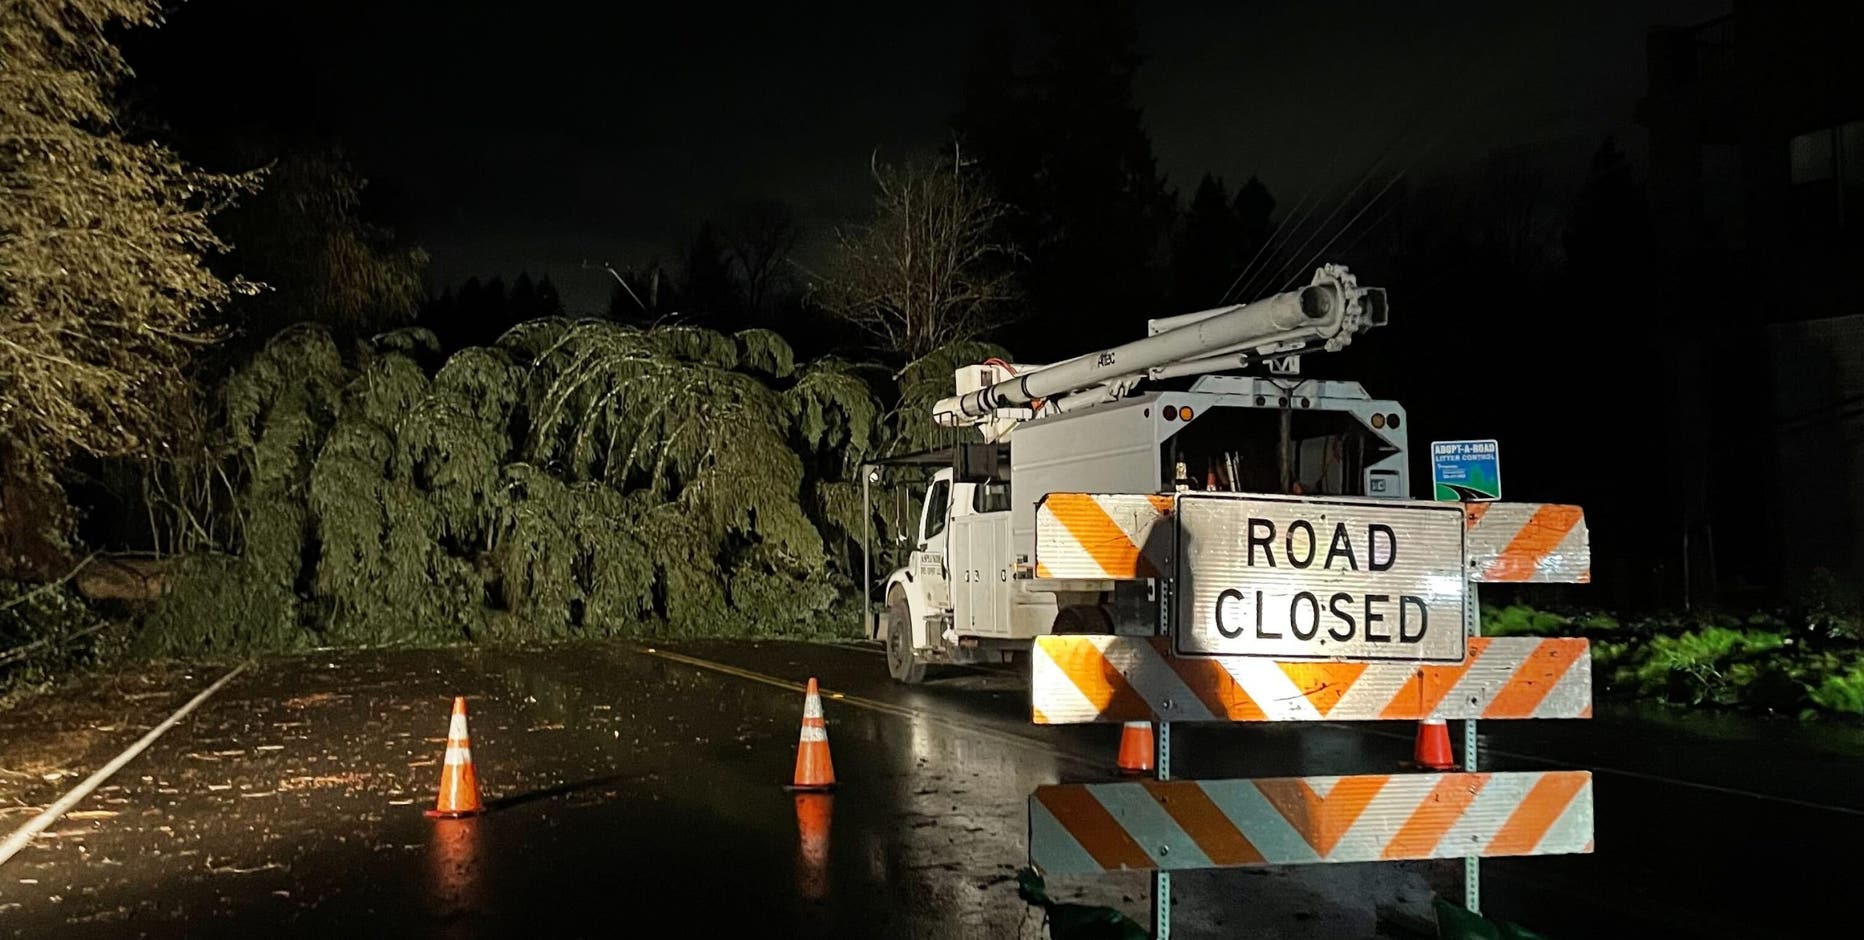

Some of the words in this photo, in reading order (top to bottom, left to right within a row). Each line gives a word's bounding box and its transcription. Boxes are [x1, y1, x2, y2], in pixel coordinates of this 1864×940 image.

[1435, 443, 1495, 454] ADOPT-A-ROAD
[1247, 518, 1397, 571] ROAD
[1215, 588, 1428, 643] CLOSED
